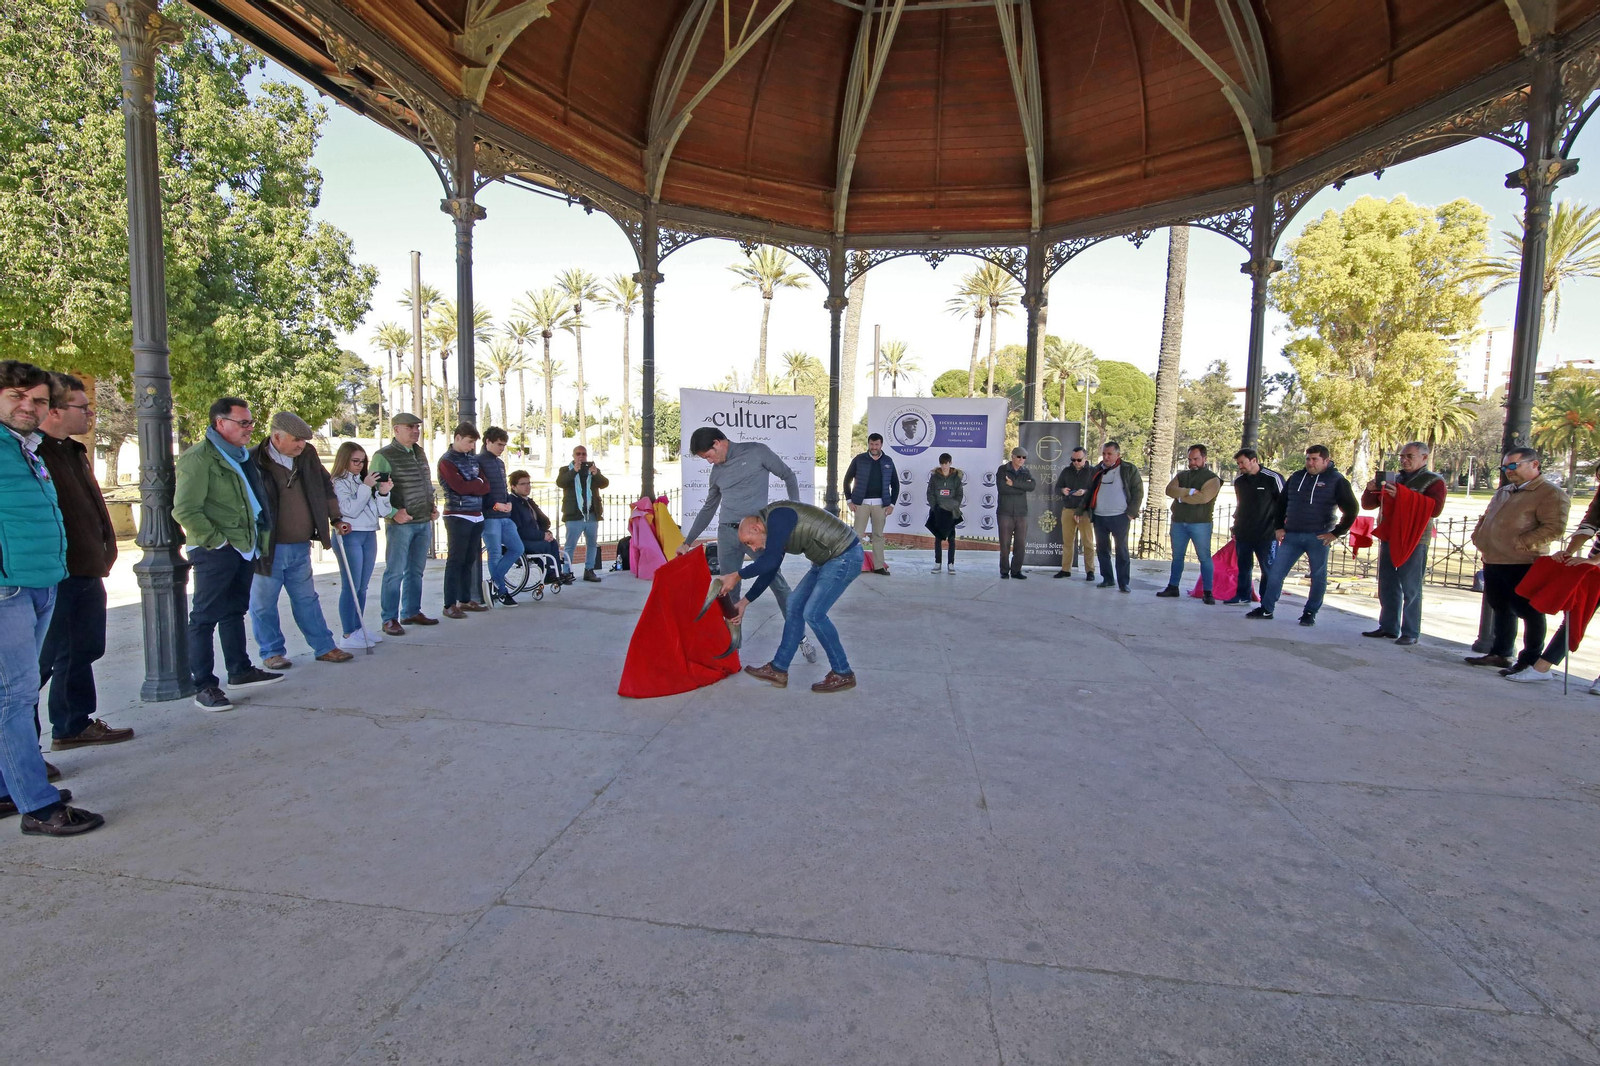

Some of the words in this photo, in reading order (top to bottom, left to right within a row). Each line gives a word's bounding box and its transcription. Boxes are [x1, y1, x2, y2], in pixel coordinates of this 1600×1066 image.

[712, 407, 786, 429] cultura
[737, 431, 771, 441] taurina
[1040, 473, 1058, 485] 1750
